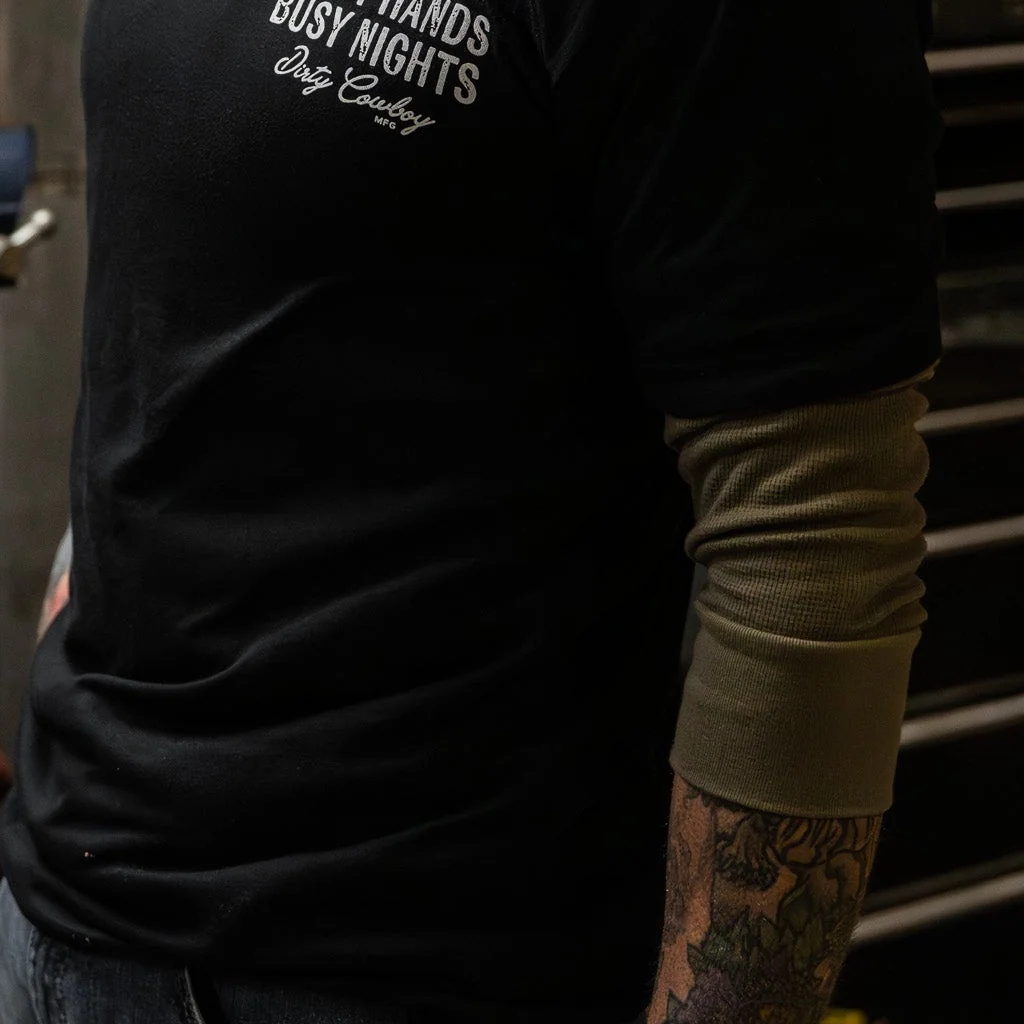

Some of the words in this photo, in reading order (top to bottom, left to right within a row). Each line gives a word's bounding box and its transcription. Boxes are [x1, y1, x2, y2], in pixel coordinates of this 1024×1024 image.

[274, 45, 333, 95] Dirty
[338, 67, 436, 136] Cowboy
[348, 18, 480, 105] NIGHTS
[374, 114, 396, 130] MFG
